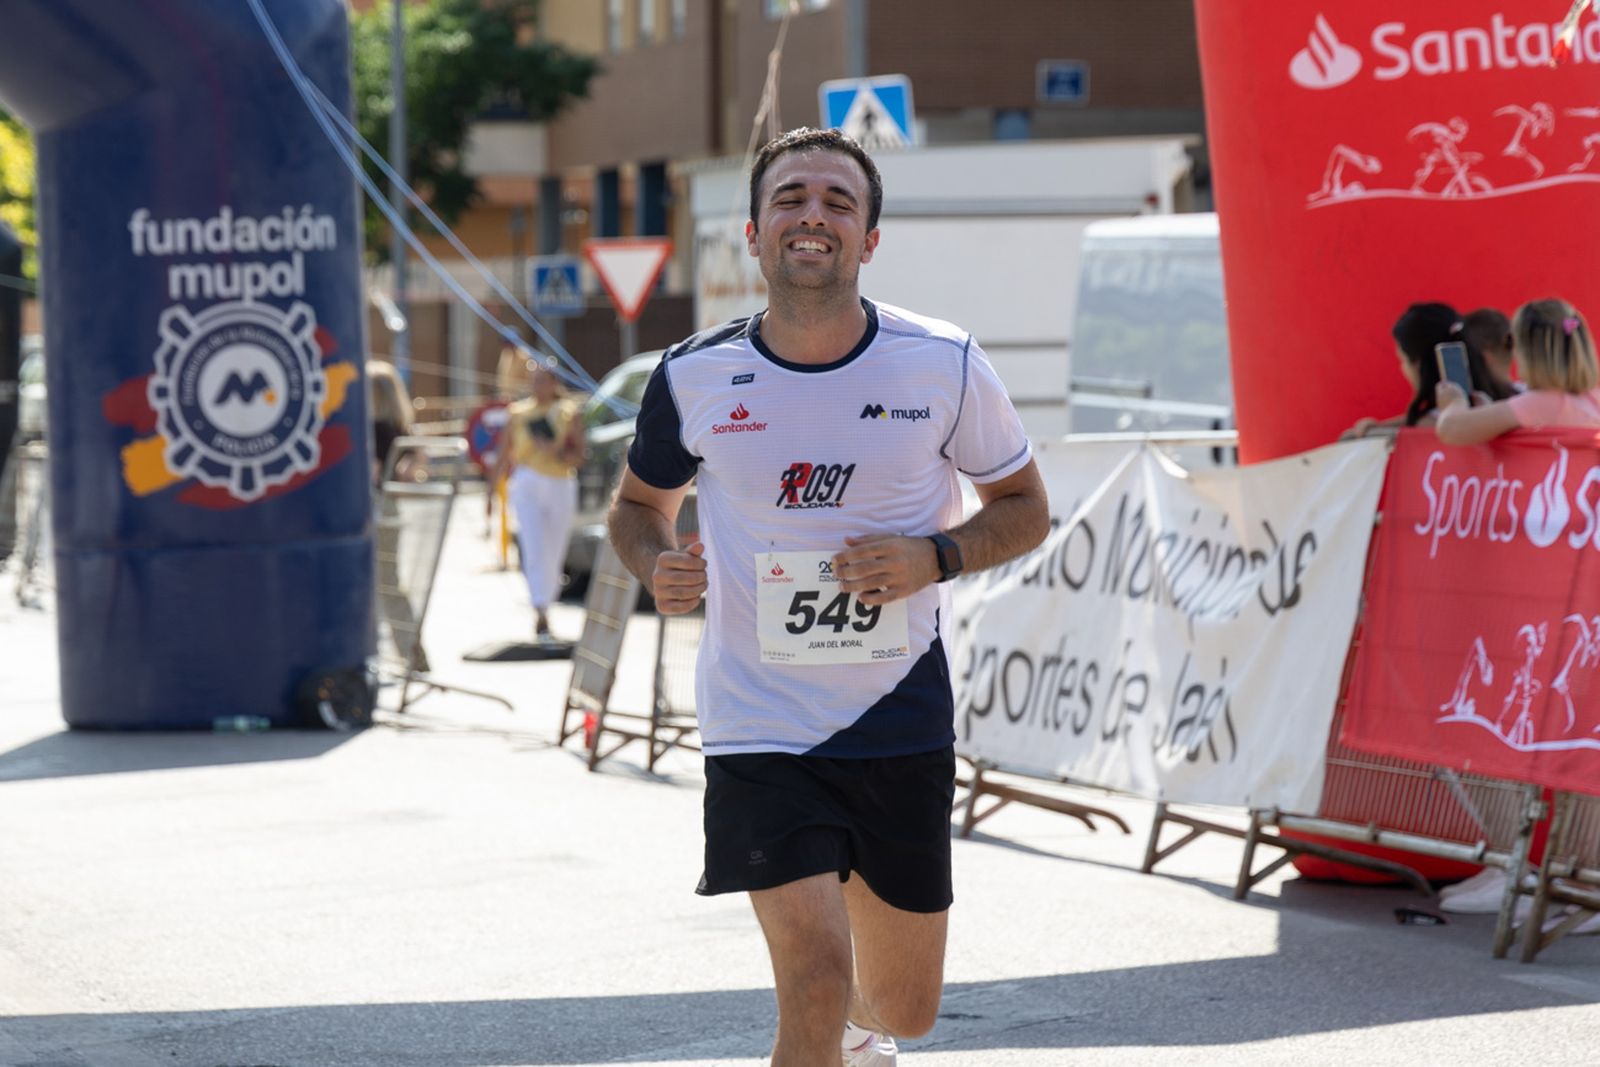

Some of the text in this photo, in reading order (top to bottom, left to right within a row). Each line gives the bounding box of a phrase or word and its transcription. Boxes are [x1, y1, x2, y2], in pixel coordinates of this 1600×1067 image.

[129, 205, 337, 254] fundación
[168, 252, 305, 304] mupol
[712, 421, 768, 434] Santander
[891, 406, 931, 422] mupol
[1414, 451, 1523, 559] Sports
[785, 590, 882, 635] 549
[808, 640, 863, 649] JUAN DEL MORAL
